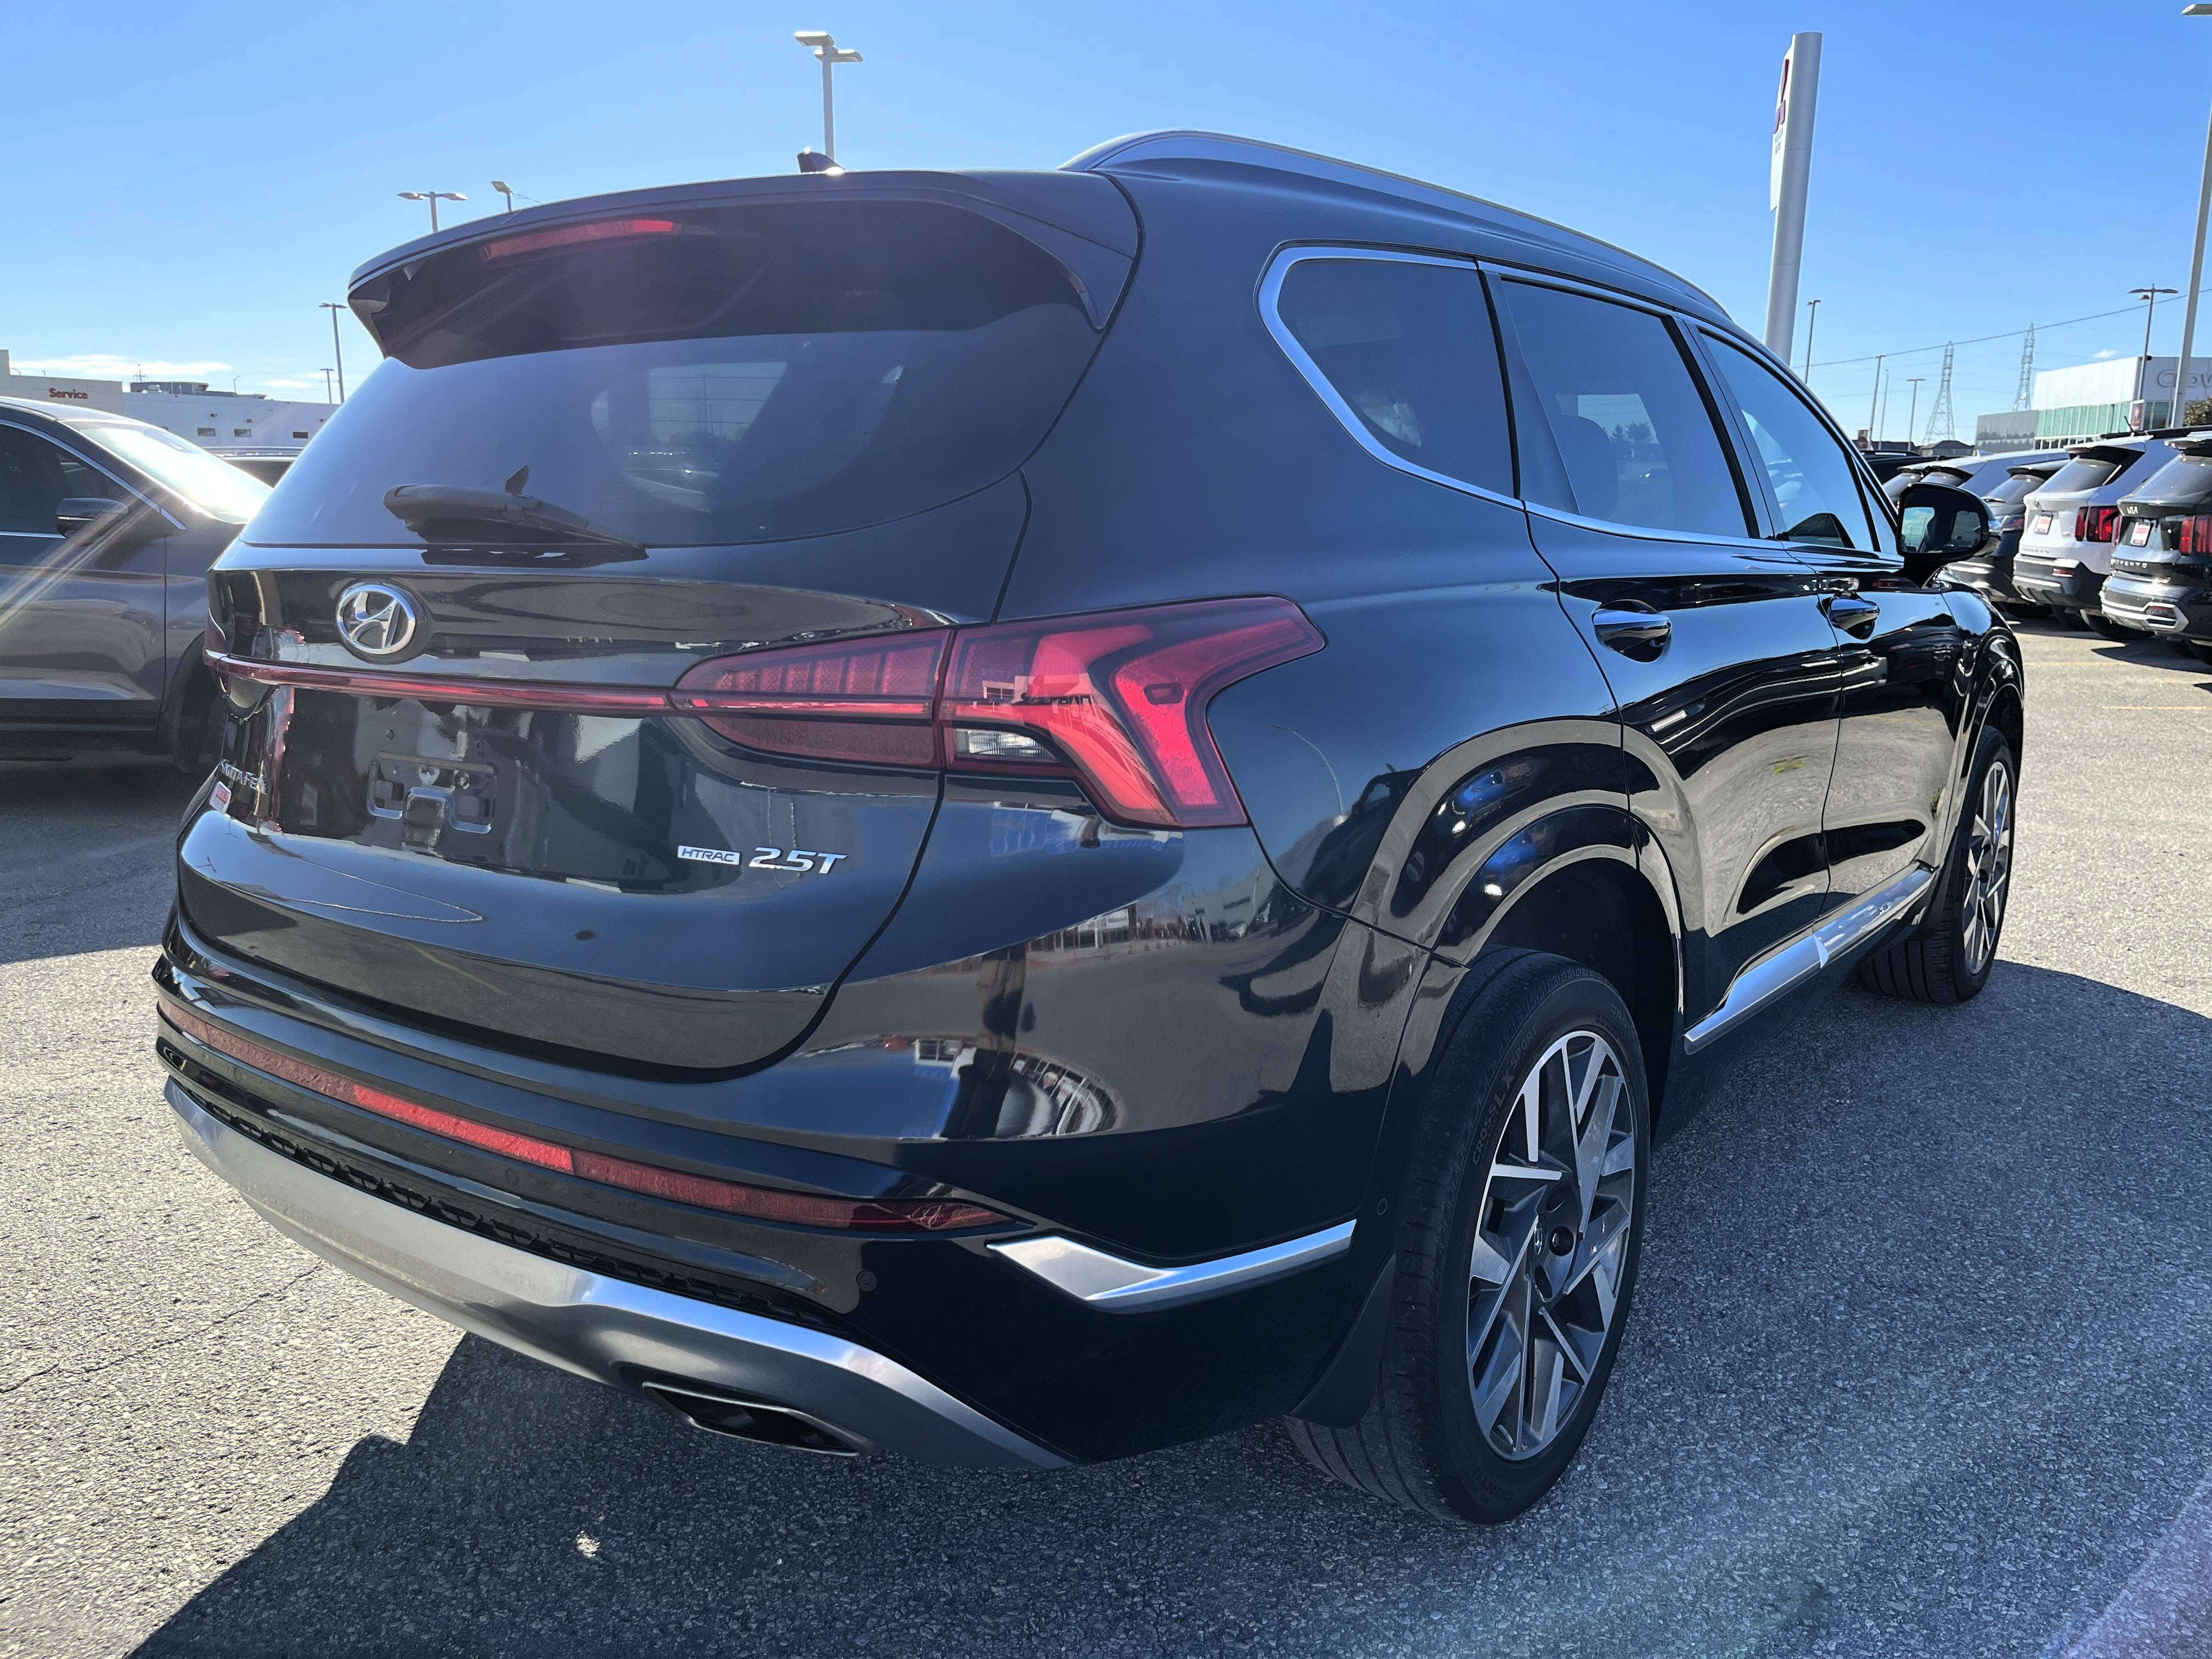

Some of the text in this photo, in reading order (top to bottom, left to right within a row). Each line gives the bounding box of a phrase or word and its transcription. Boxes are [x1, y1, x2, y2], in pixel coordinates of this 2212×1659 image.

[49, 387, 88, 399] Service
[681, 847, 735, 863] HTRAC
[1471, 1103, 1498, 1164] CROSS
[1510, 1025, 1537, 1068] SPORT
